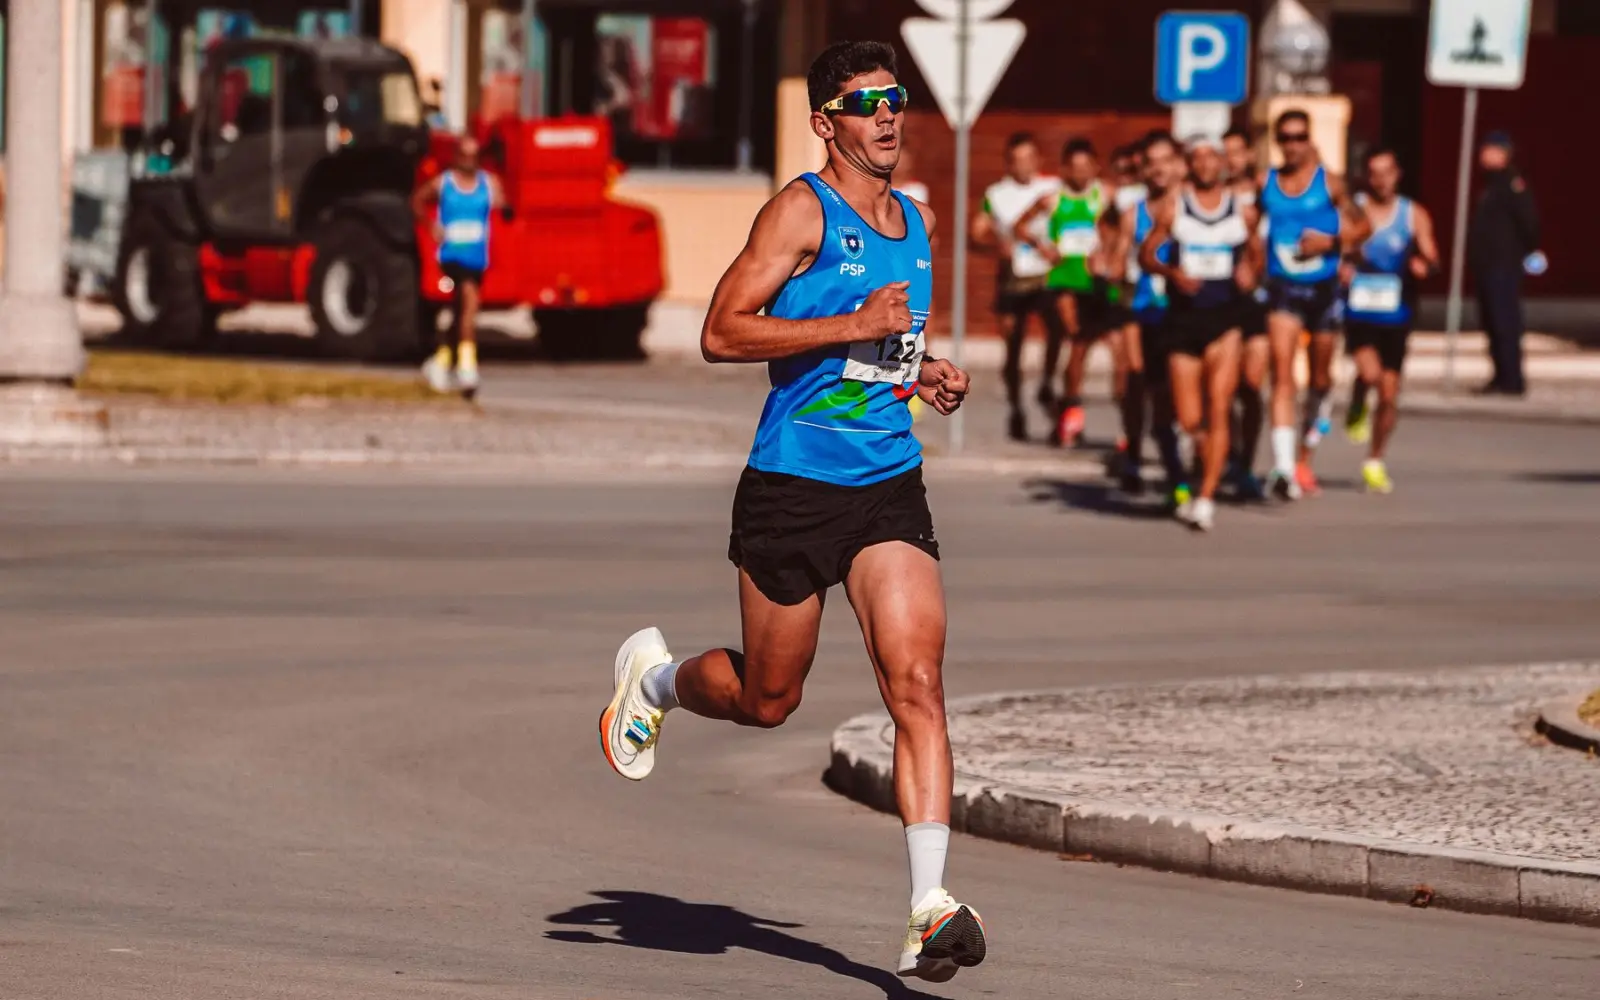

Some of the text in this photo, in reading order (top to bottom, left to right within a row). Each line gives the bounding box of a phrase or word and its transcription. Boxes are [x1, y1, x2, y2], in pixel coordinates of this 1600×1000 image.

[1178, 23, 1226, 92] P
[840, 262, 866, 277] PSP
[874, 338, 916, 364] 122
